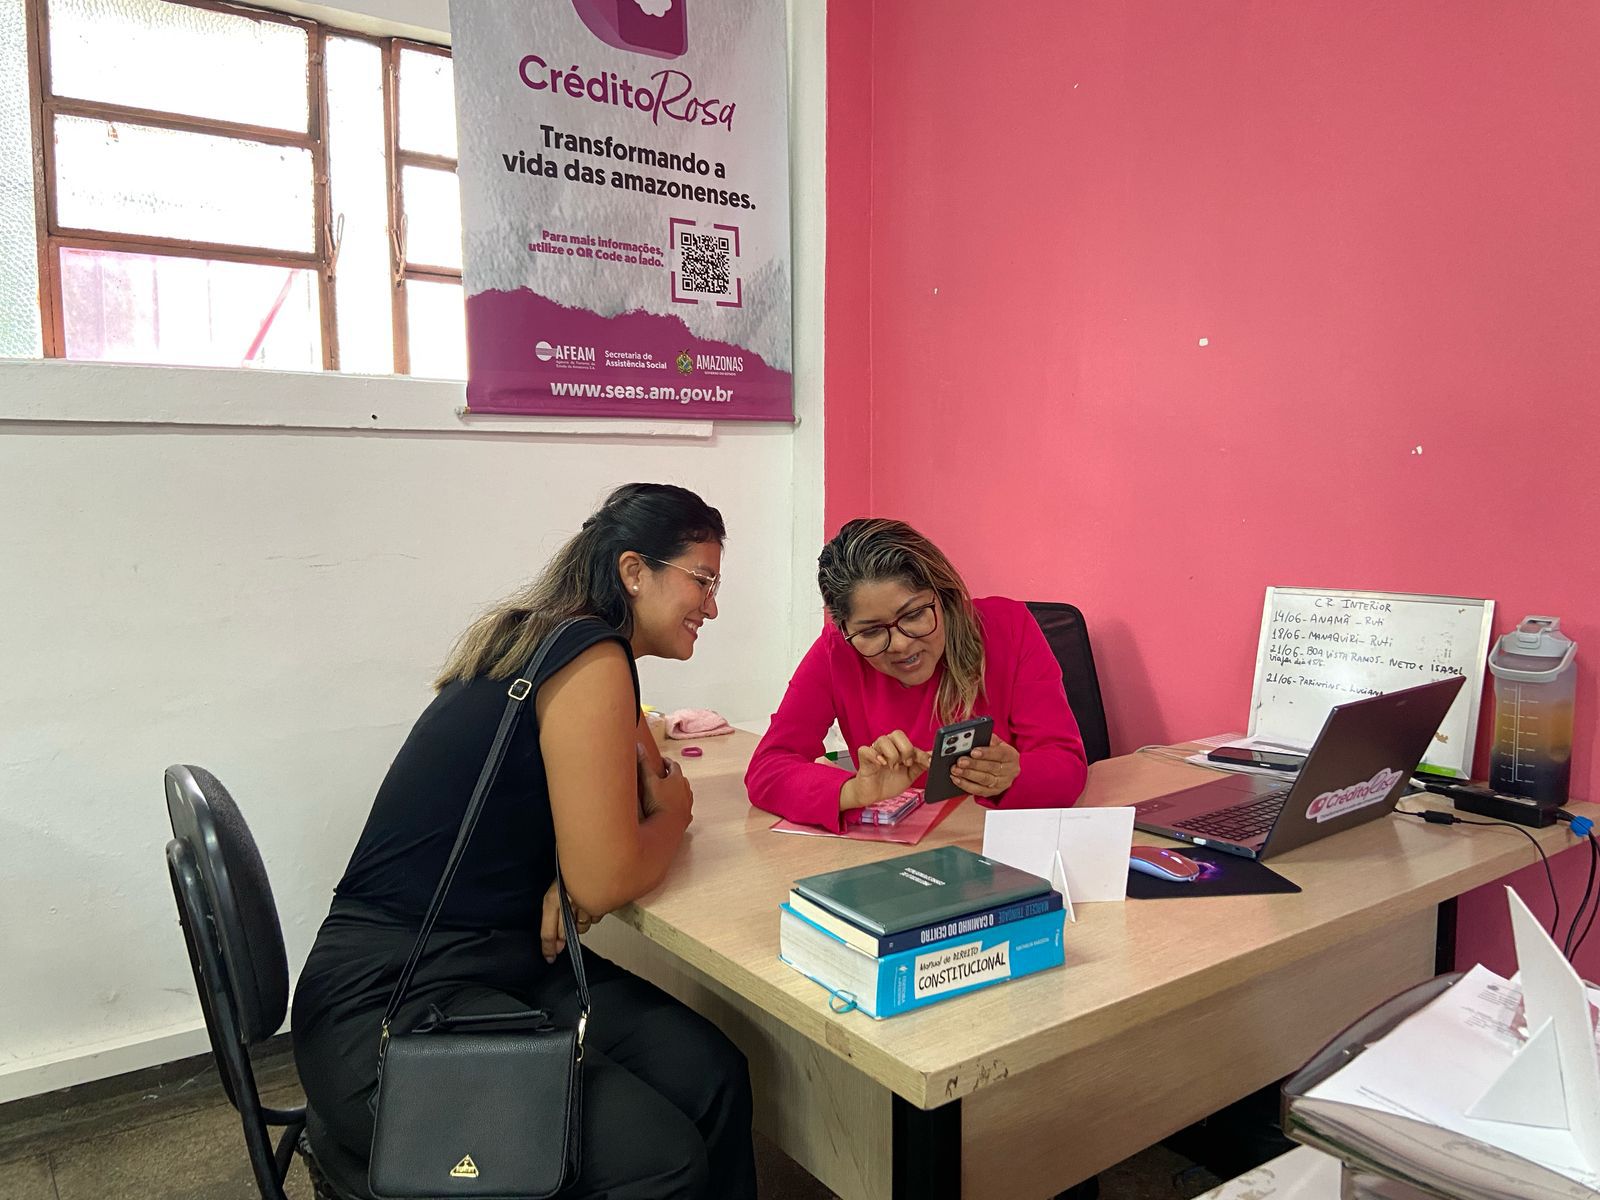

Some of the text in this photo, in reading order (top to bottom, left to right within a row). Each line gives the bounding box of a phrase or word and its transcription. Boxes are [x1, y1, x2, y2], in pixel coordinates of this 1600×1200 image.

[540, 124, 726, 179] Transformando a
[502, 152, 756, 210] vida das amazonenses.
[528, 241, 664, 268] utilize o QR Code ao lado.
[542, 230, 664, 257] Para mais informações,
[555, 344, 595, 362] AFEAM
[605, 350, 653, 361] Secretaria de
[605, 358, 646, 369] Assistência
[647, 361, 667, 370] Social
[696, 354, 744, 372] AMAZONAS
[550, 382, 734, 404] www.seas.am.gov.br
[1310, 613, 1351, 625] ANAMÃ
[1389, 658, 1416, 670] NETO
[920, 913, 994, 944] O CAMINHO DO CENTRO
[919, 956, 942, 971] Manual
[952, 946, 979, 961] DIREITO
[918, 952, 1006, 991] CONSTITUCIONAL
